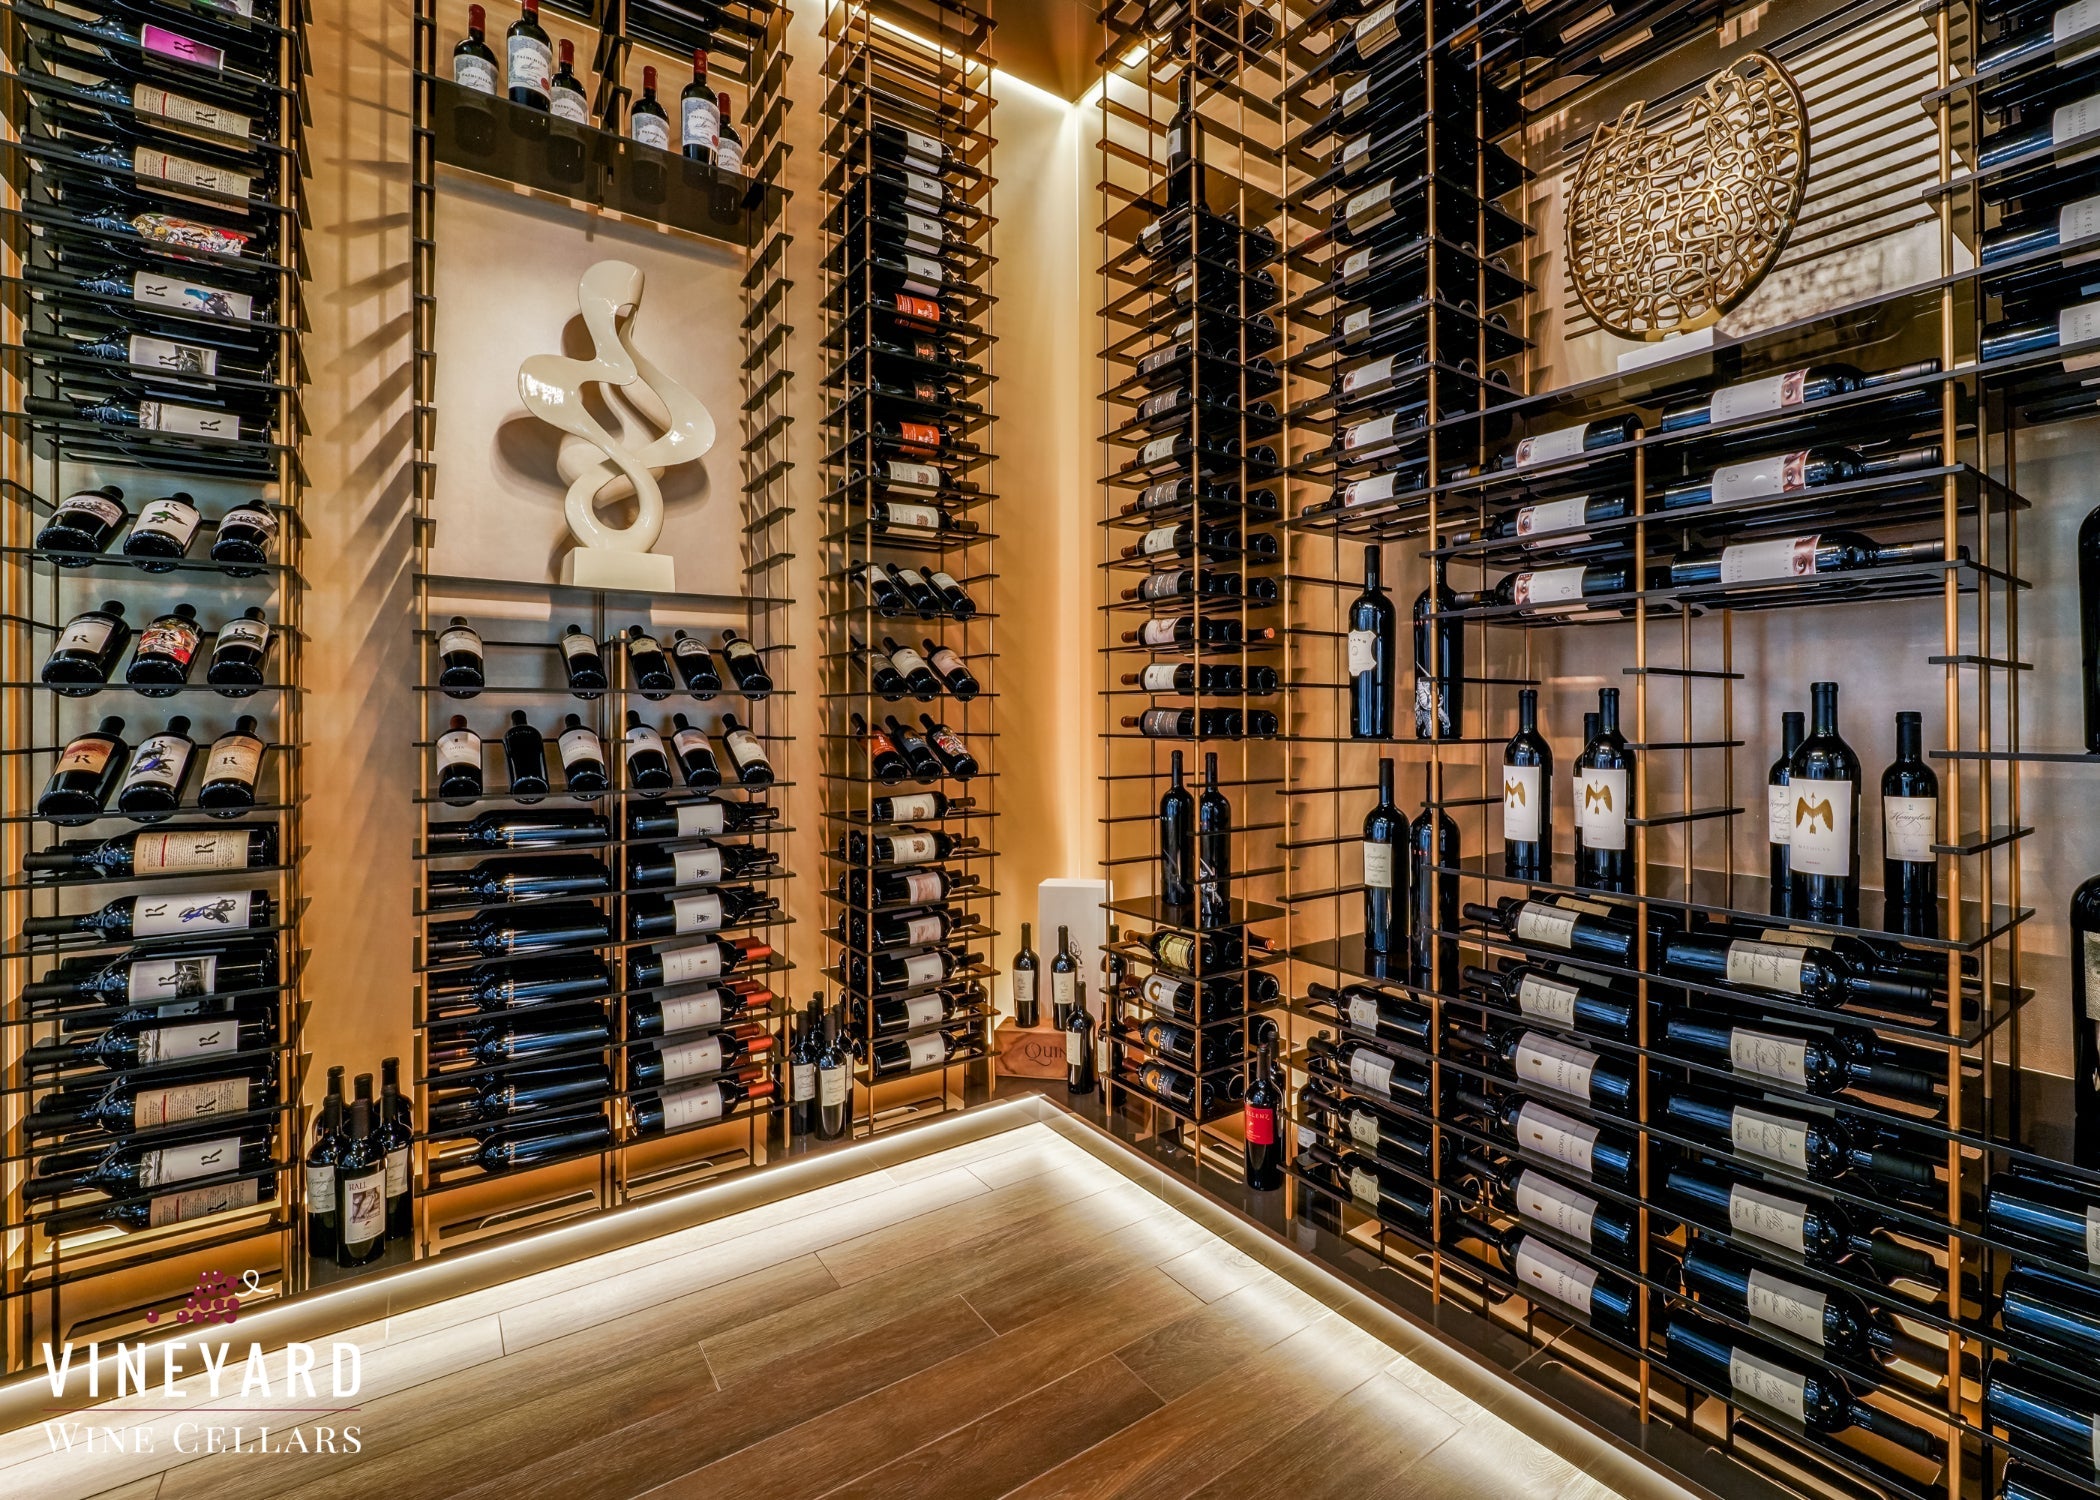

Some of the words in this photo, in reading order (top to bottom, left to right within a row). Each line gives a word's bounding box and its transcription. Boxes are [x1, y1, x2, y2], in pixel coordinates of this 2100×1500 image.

[196, 110, 217, 126] R
[196, 174, 217, 190] R
[145, 282, 168, 299] R
[200, 417, 222, 434] R
[73, 754, 92, 766] R
[222, 756, 237, 766] R
[195, 839, 217, 859] R
[145, 903, 169, 920] R
[199, 1030, 222, 1048] R
[196, 1098, 217, 1116] R
[201, 1147, 223, 1167] R
